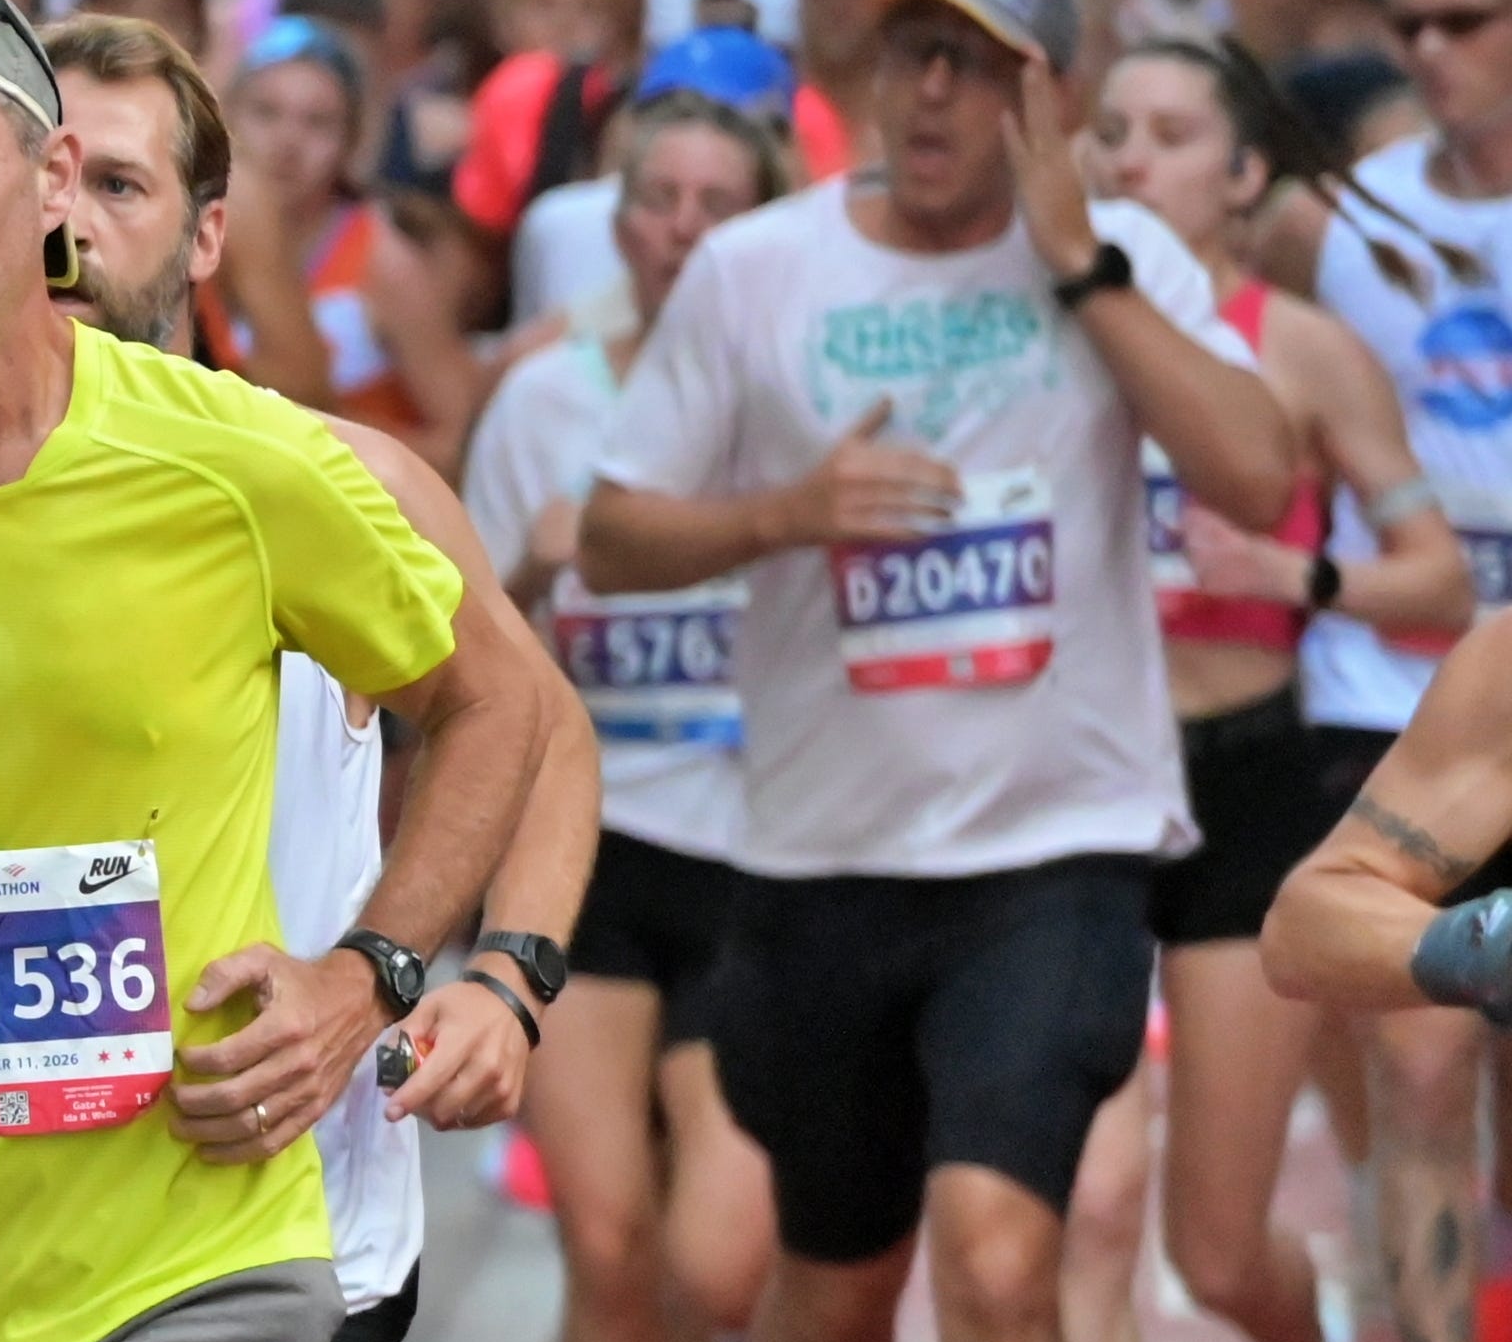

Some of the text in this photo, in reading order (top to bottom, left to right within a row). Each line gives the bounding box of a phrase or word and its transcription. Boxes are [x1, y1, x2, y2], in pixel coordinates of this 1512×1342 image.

[89, 855, 132, 877] RUN
[16, 1056, 39, 1070] 11,
[42, 1052, 80, 1069] 2026
[72, 1101, 97, 1111] Gate
